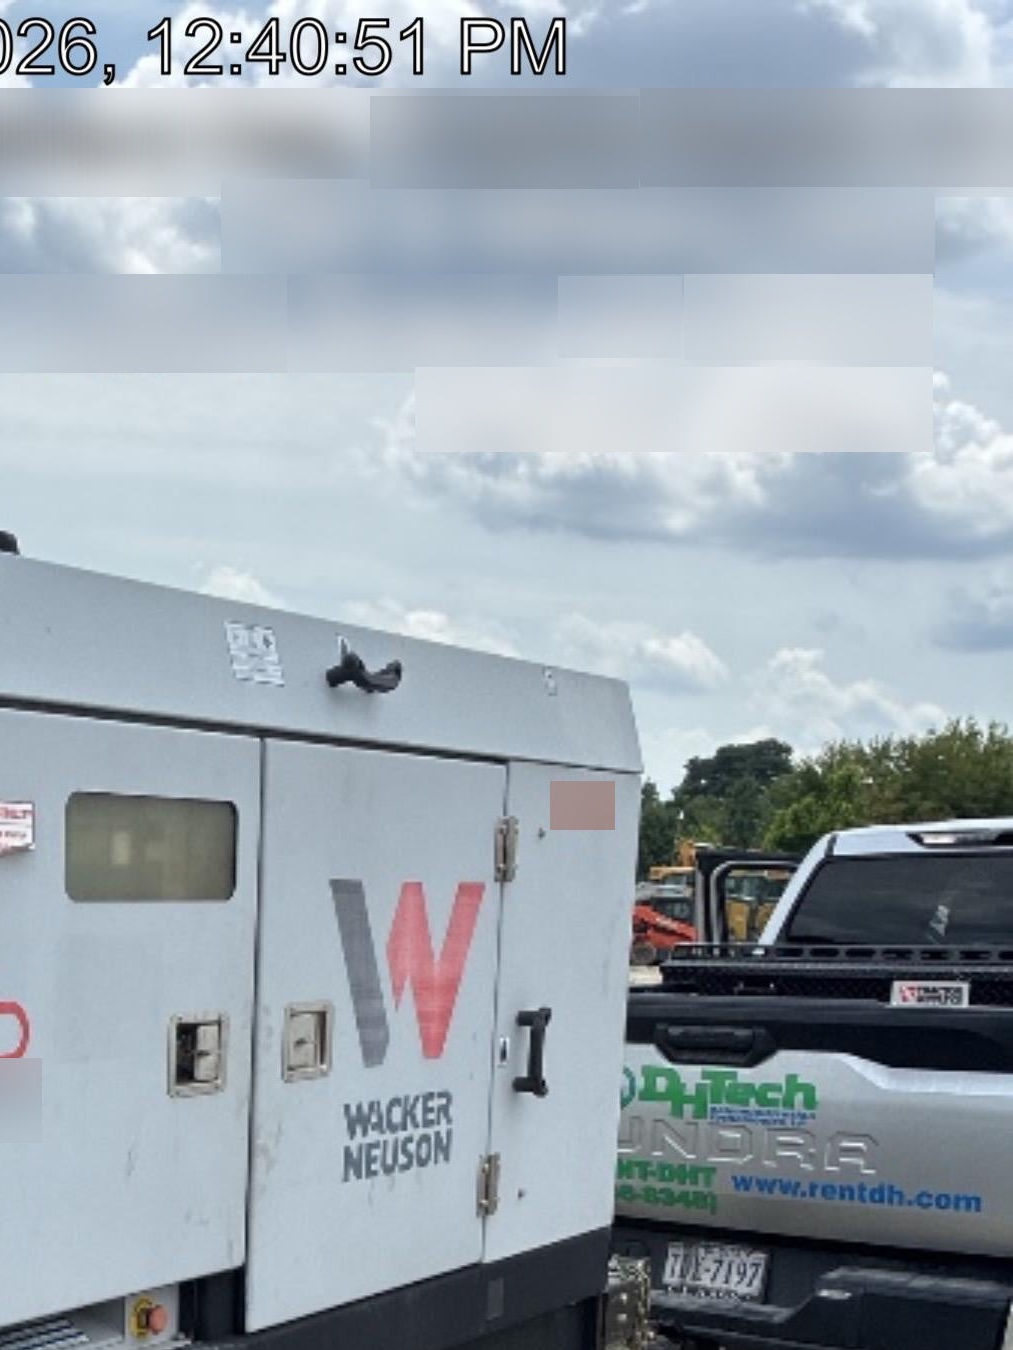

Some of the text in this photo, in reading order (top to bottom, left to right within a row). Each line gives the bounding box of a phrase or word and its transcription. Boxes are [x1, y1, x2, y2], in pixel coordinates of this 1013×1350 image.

[343, 1091, 453, 1140] WACKER
[342, 1130, 452, 1183] NEUSON
[731, 1175, 982, 1213] www.rentdh.com
